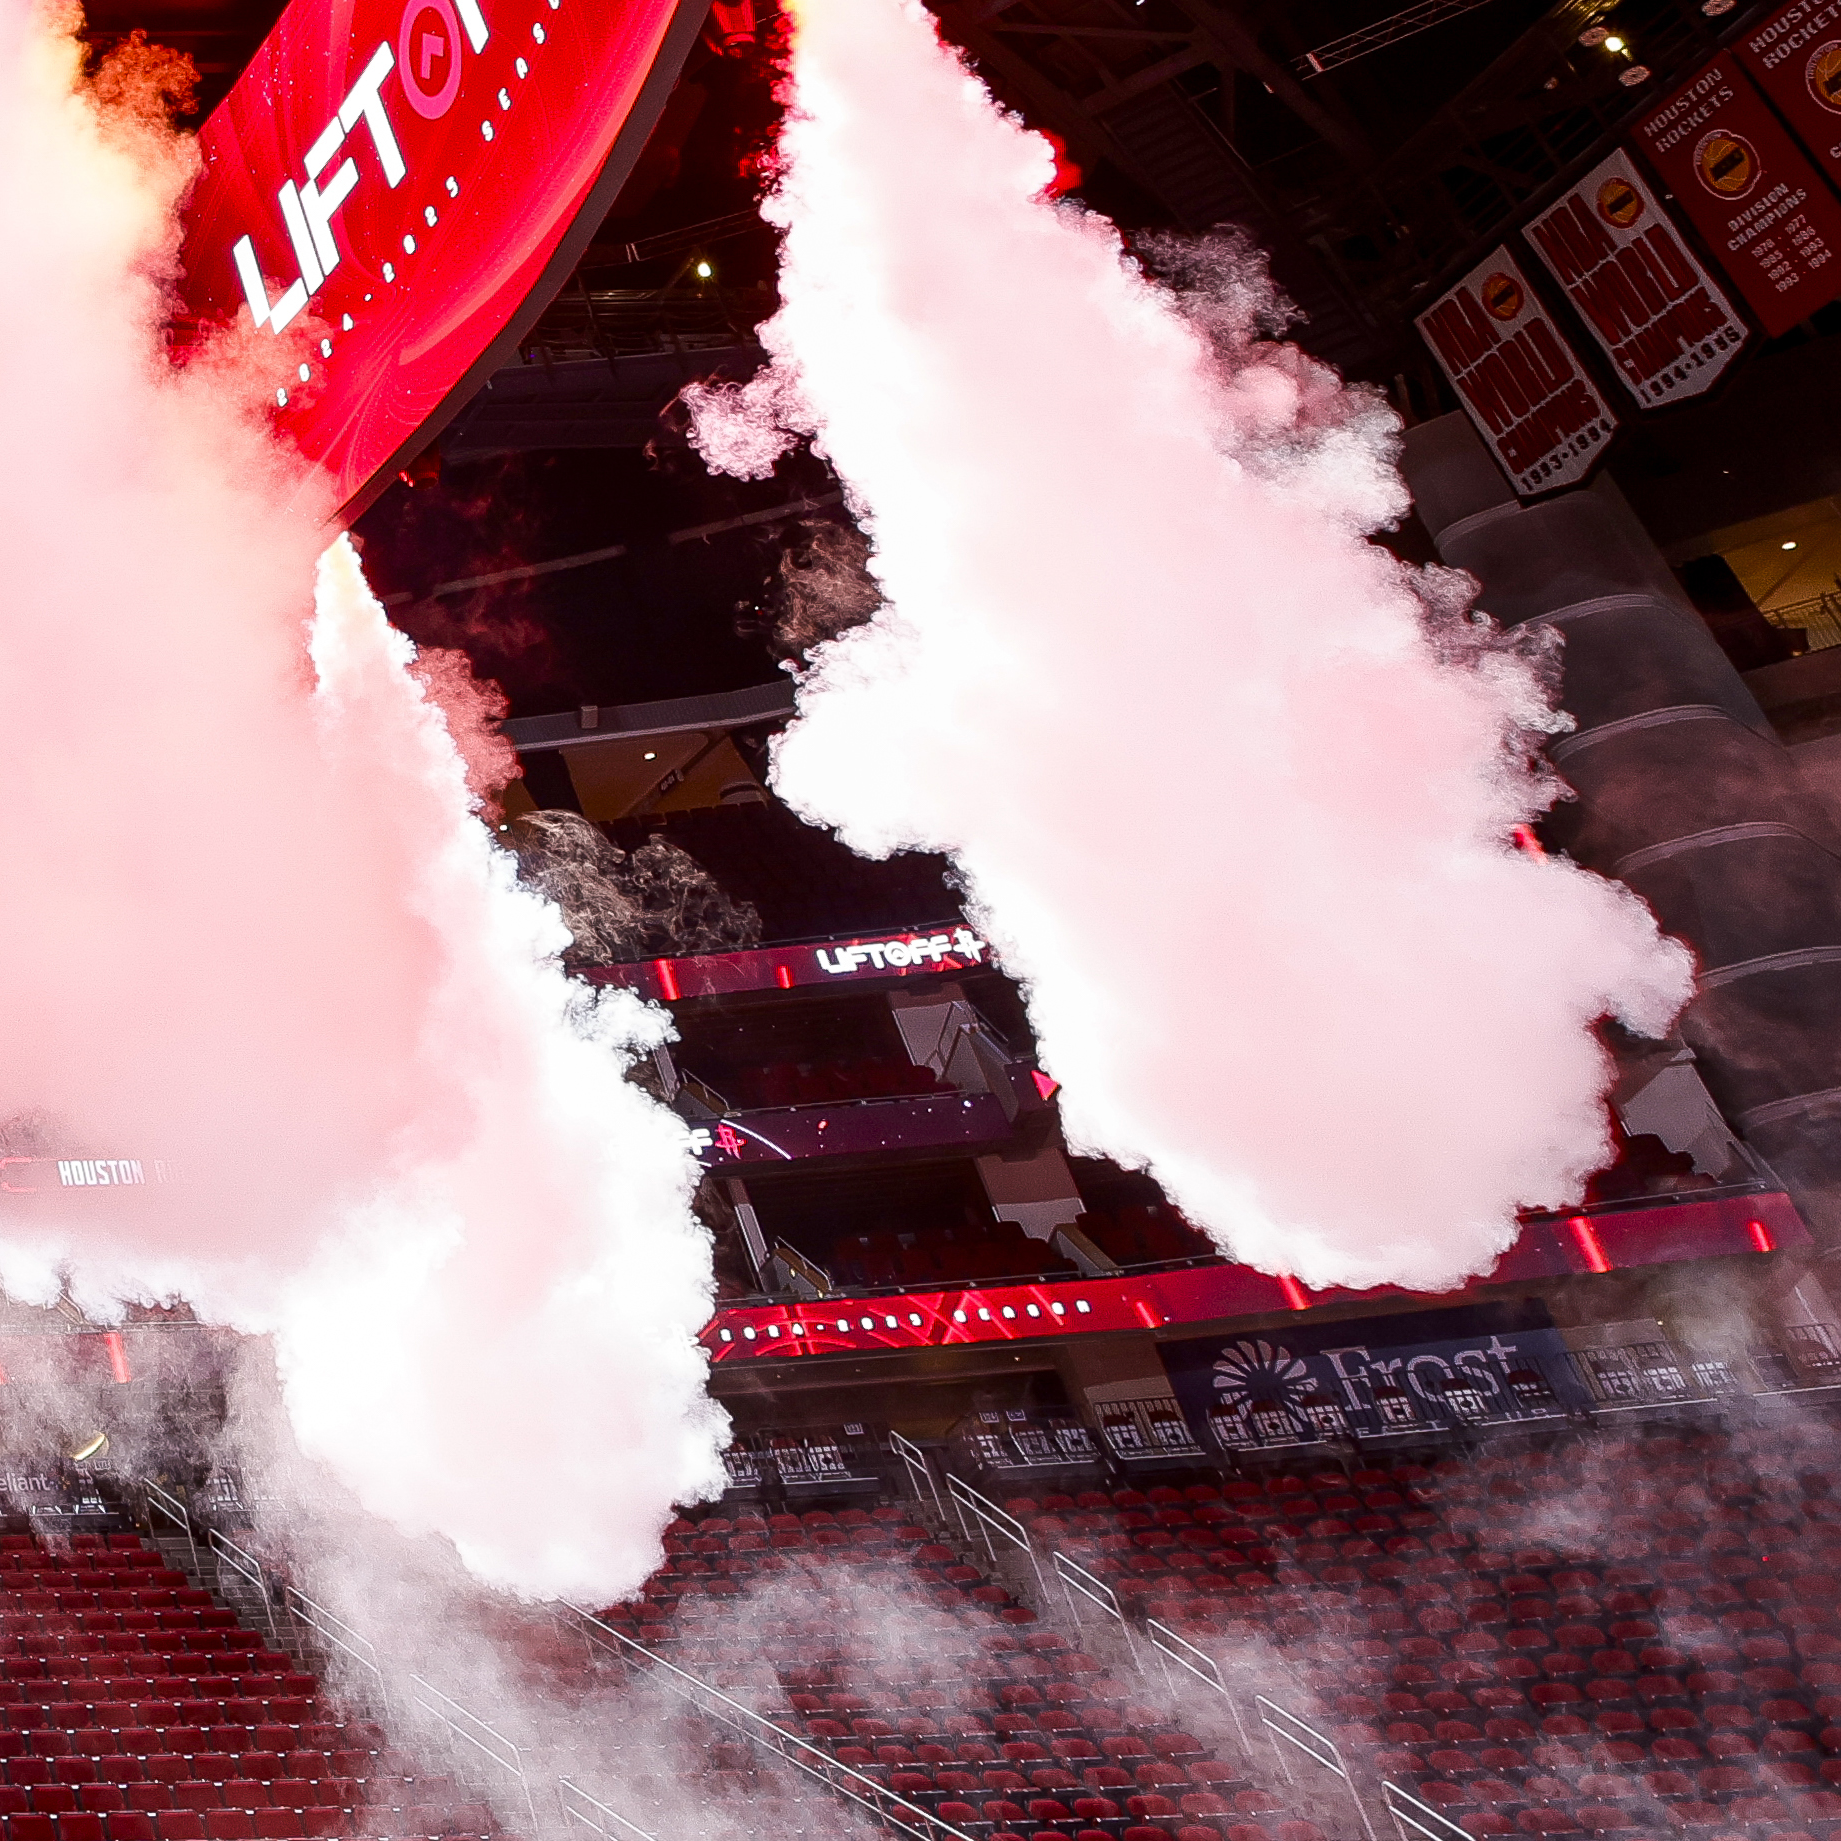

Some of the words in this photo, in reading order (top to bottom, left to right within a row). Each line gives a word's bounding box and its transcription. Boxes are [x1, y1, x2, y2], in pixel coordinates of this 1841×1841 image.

[1643, 68, 1723, 137] HOUSTON
[1655, 86, 1734, 153] ROCKETS
[1531, 192, 1618, 287] NBA
[1727, 182, 1789, 232] DIVISION
[1727, 188, 1807, 251] CHAMPIONS
[1570, 223, 1700, 347] WORLD
[1422, 286, 1502, 376] NBA
[1612, 286, 1728, 386] CHAMPIONS
[1456, 317, 1575, 438] WORLD
[1496, 379, 1600, 475] CHAMPIONS
[816, 933, 952, 974] LIFTOFF
[57, 1160, 146, 1186] HOUSTON
[1320, 1335, 1518, 1412] Frost
